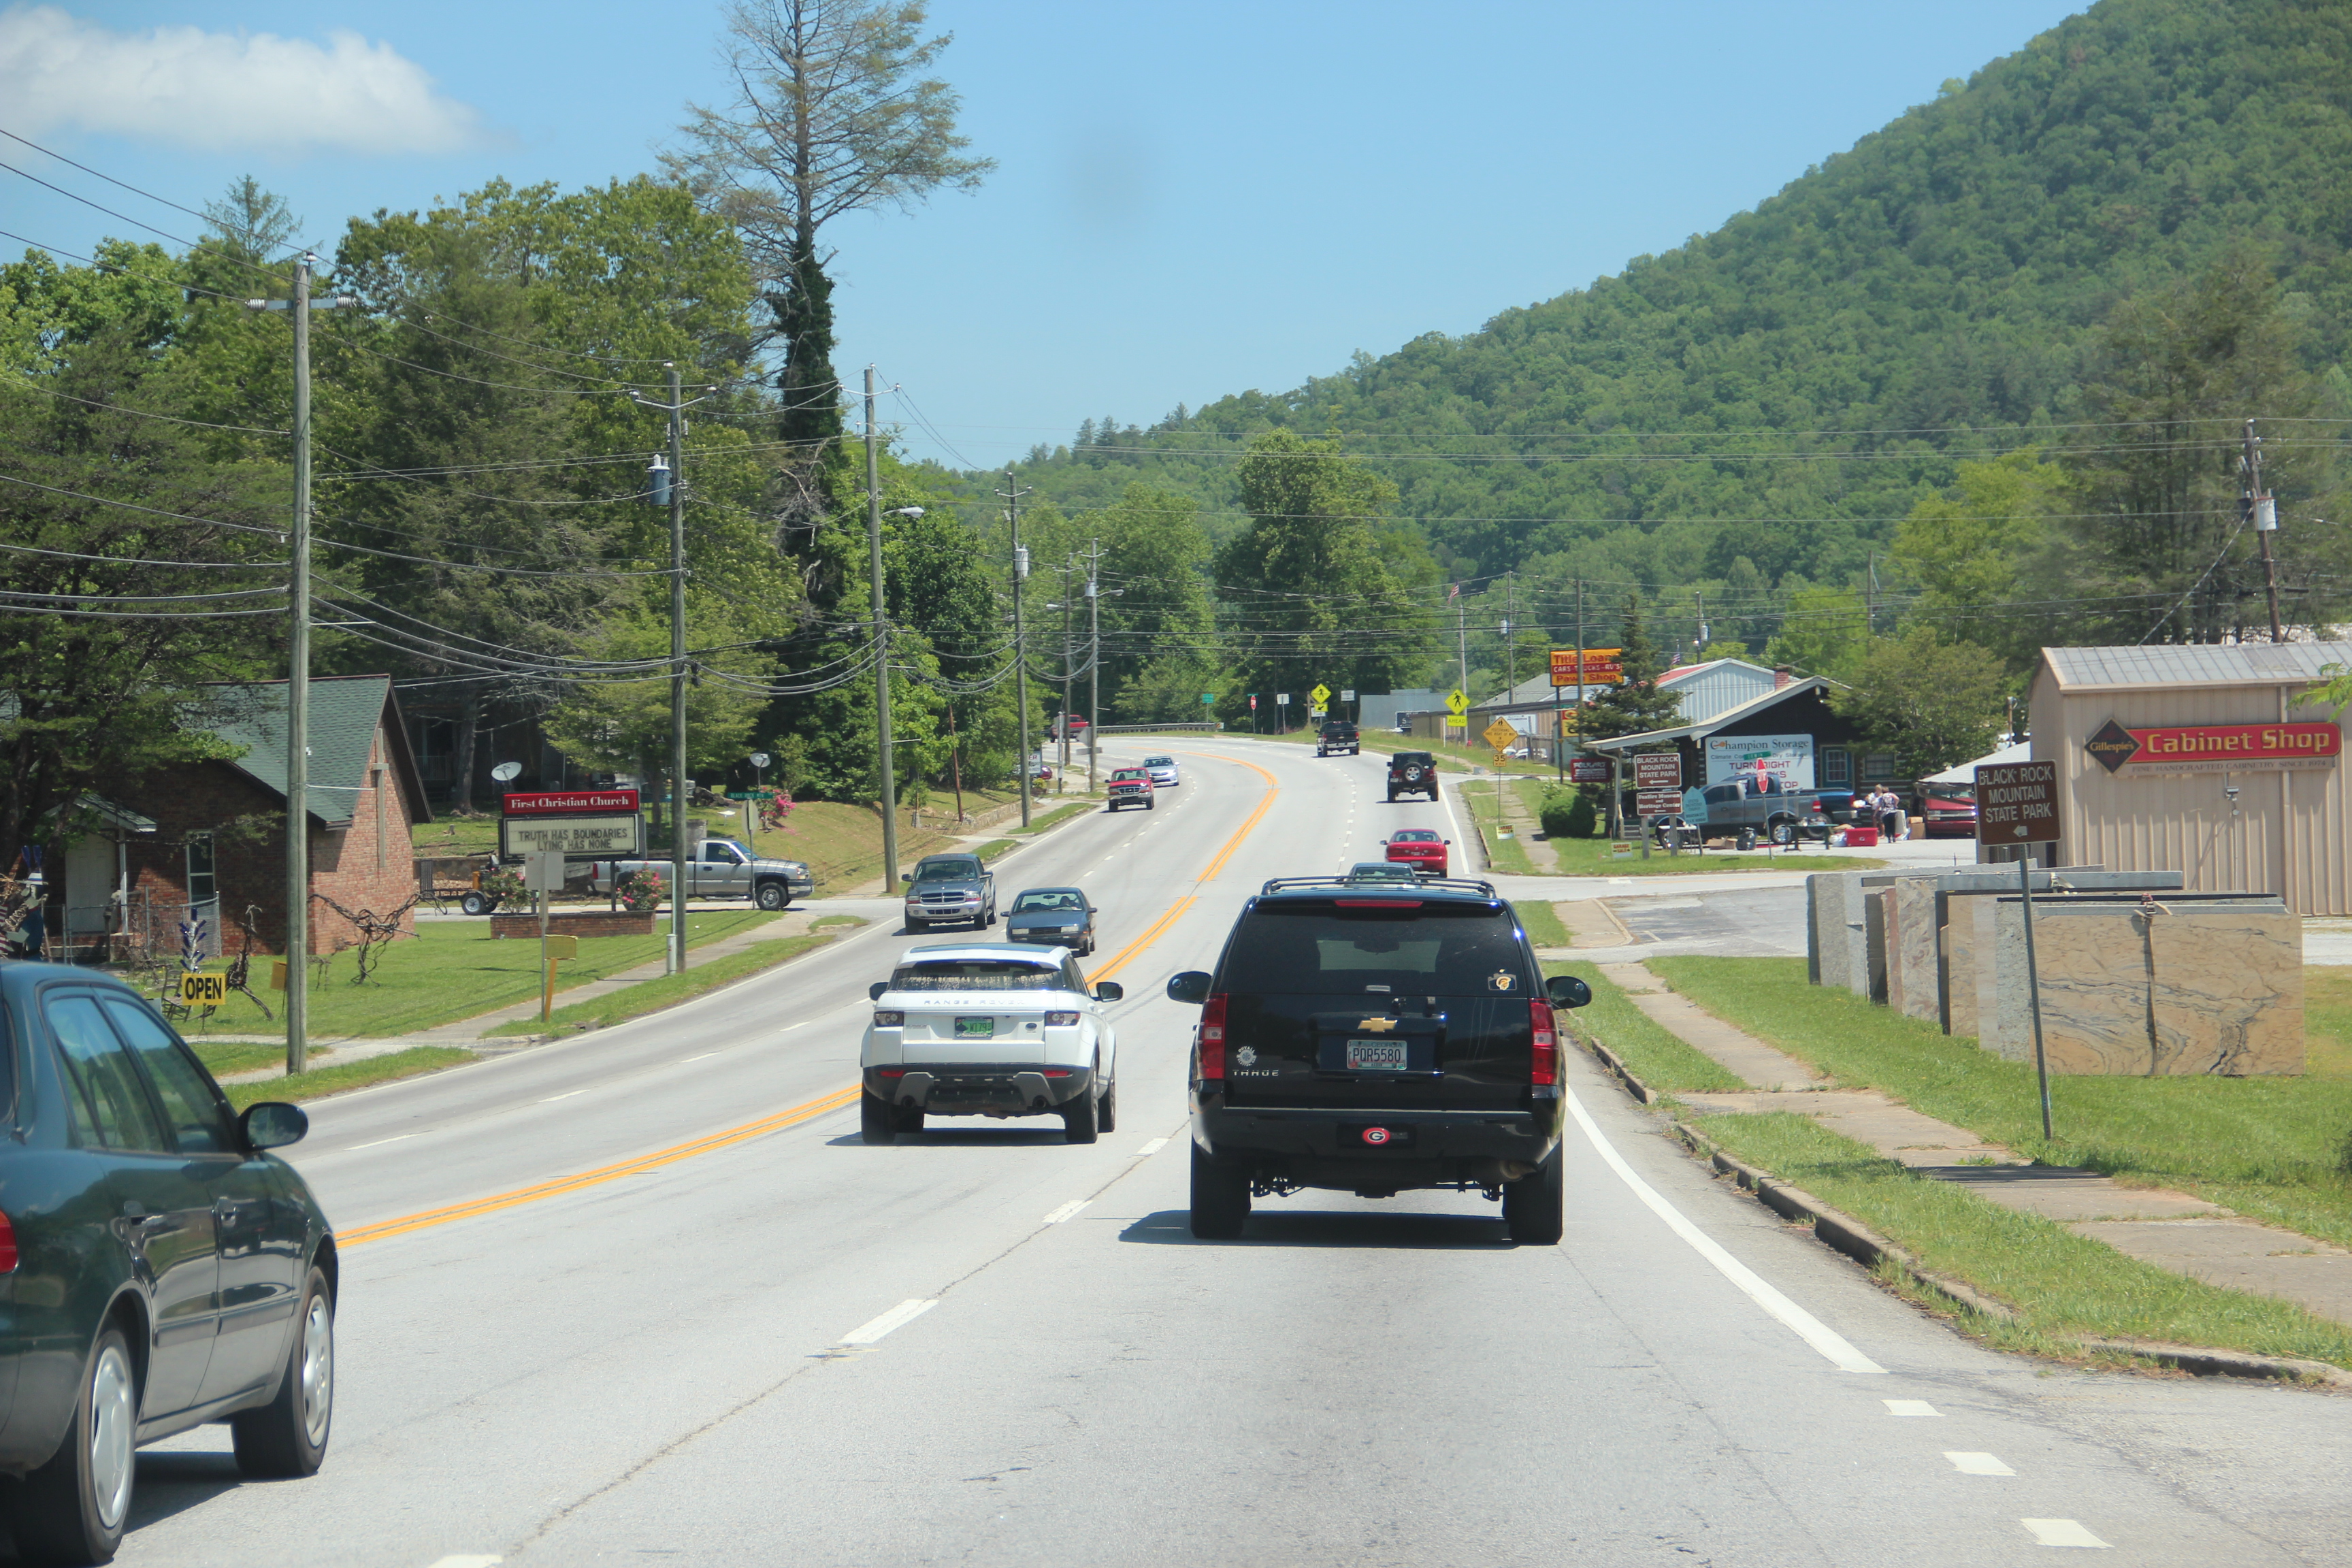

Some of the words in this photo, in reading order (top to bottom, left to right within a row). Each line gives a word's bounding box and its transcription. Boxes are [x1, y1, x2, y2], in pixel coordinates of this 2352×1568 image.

[1554, 655, 1578, 664] Title
[1583, 653, 1619, 663] Loan
[1589, 673, 1616, 682] Shop
[1710, 740, 1768, 751] Champion
[1772, 739, 1809, 748] Storage
[2089, 741, 2135, 753] Gillespie's
[2146, 732, 2253, 753] Cabinet
[2261, 730, 2330, 753] Shop
[1729, 762, 1757, 770] TURN
[2156, 762, 2223, 772] HANDCRAFTED
[2225, 761, 2274, 769] CABINETRY
[1978, 768, 2016, 785] BLACK
[2020, 766, 2053, 782] ROCK
[1989, 785, 2046, 804] MOUNTAIN
[511, 799, 536, 808] First
[538, 797, 587, 808] Christian
[590, 796, 629, 806] Church
[1985, 806, 2019, 823] STATE
[2022, 802, 2053, 819] PARK
[519, 830, 549, 841] TRUTH
[551, 830, 569, 840] HAS
[574, 828, 627, 839] BOUNDARIES
[538, 840, 564, 851] LYING
[568, 840, 585, 850] HAS
[589, 838, 612, 849] NONE
[185, 977, 222, 1000] OPEN
[1353, 1048, 1401, 1062] PQR5580
